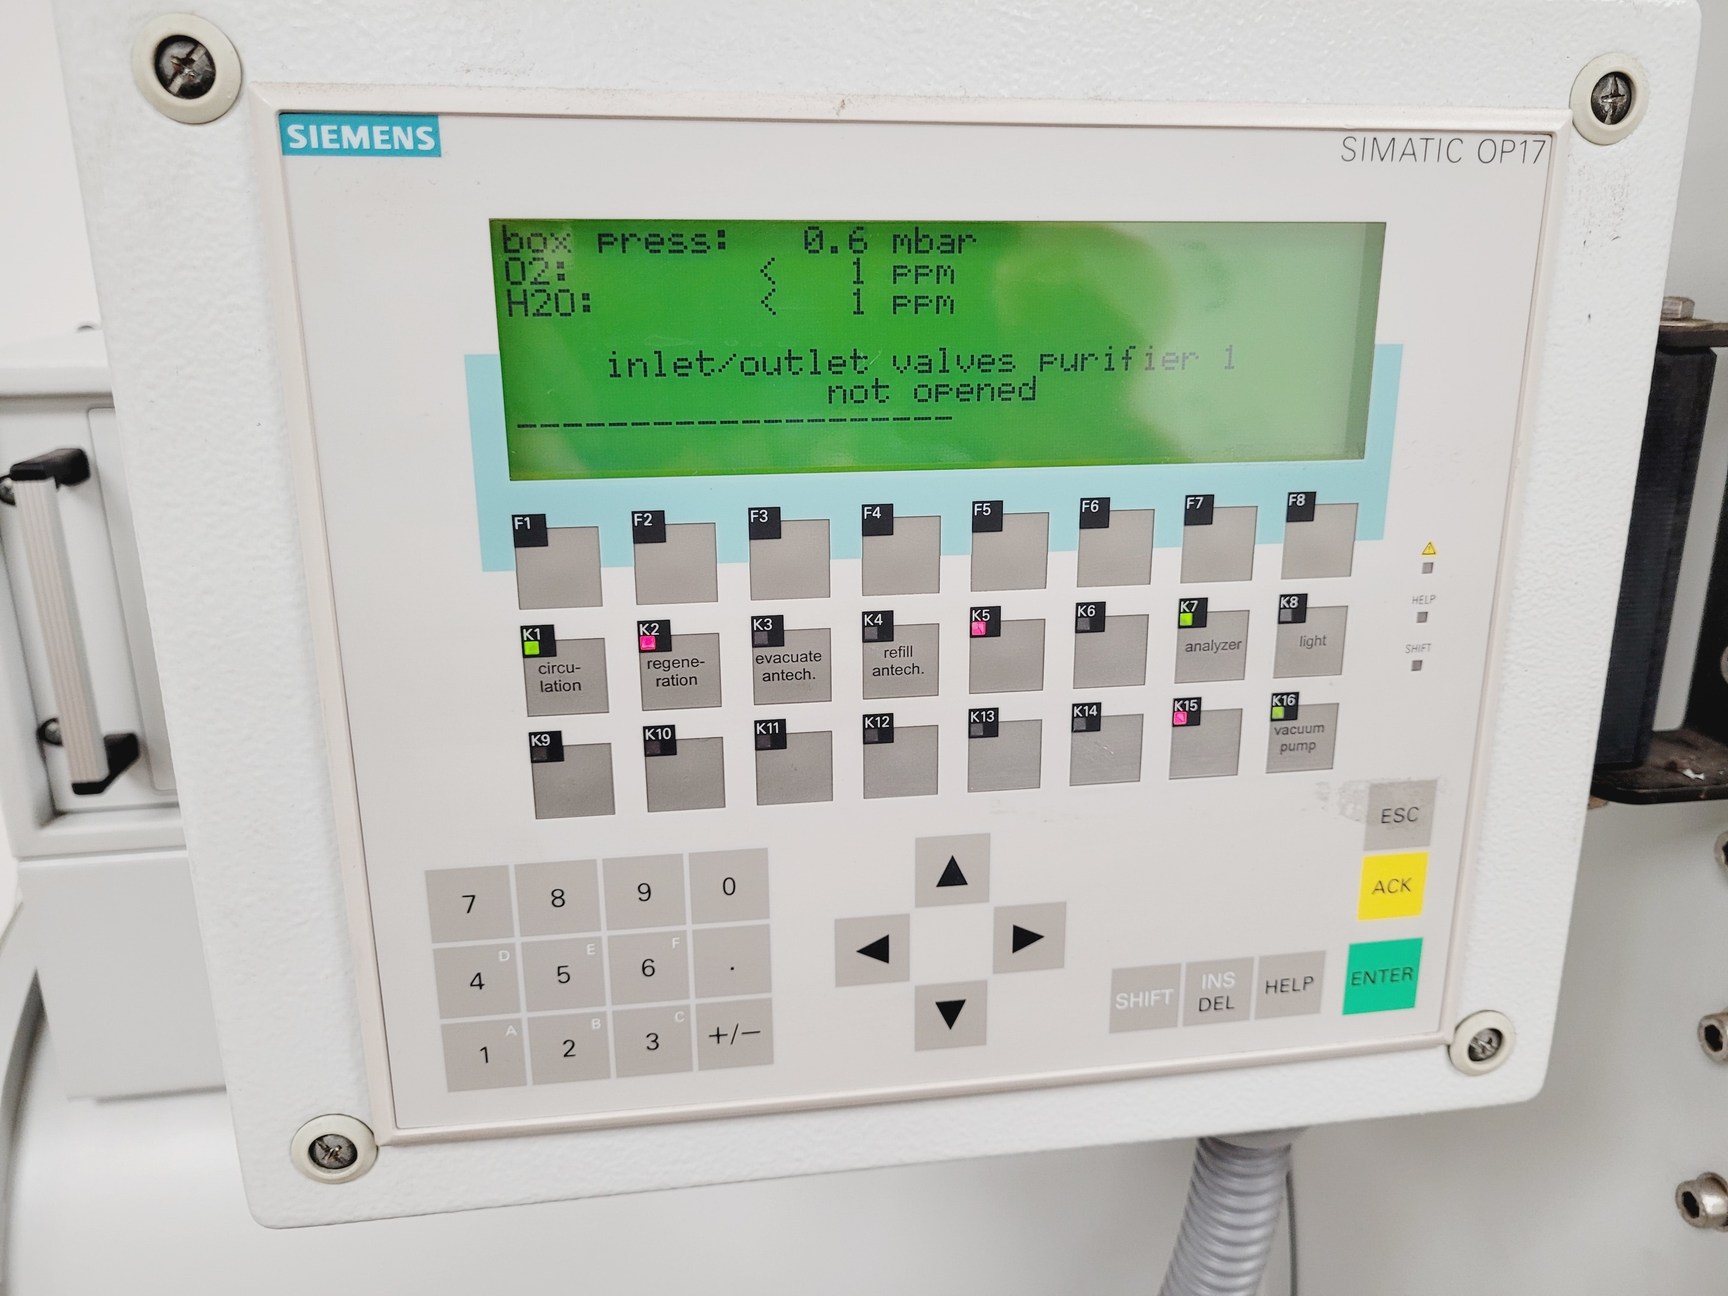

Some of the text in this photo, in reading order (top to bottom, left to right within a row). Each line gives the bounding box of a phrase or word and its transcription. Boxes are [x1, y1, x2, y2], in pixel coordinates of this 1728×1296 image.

[287, 124, 435, 150] SIEMENS
[1341, 136, 1546, 164] SIMATIC OP17
[503, 225, 977, 255] box press: 0.6 mbar
[852, 257, 865, 285] 1
[892, 264, 956, 286] ppm
[507, 289, 591, 317] H2O:
[852, 288, 865, 315] 1
[892, 295, 956, 316] ppm
[608, 345, 1236, 378] inlet/outlet valves purifier 1
[828, 375, 1038, 405] not opened
[1082, 500, 1099, 512] F6
[1187, 497, 1204, 509] F7
[1289, 494, 1306, 506] F8
[750, 510, 768, 522] F3
[864, 506, 881, 519] F4
[974, 503, 991, 516] F5
[514, 517, 531, 530] F1
[634, 513, 652, 526] F2
[1280, 596, 1298, 608] K8
[1412, 594, 1436, 604] HELP
[1078, 605, 1096, 617] K6
[1180, 601, 1198, 613] K7
[864, 614, 883, 626] K4
[972, 609, 990, 622] K5
[640, 624, 659, 636] K2
[753, 618, 772, 631] K3
[523, 628, 540, 640] K1
[1185, 639, 1242, 655] analyzer
[1300, 634, 1326, 650] light
[884, 645, 913, 658] refill
[1405, 644, 1432, 654] SHIFT
[756, 650, 822, 664] evacuate
[538, 662, 581, 675] circu-
[647, 656, 705, 672] regene-
[873, 663, 924, 677] antech.
[656, 675, 697, 687] ration
[762, 668, 816, 682] antech.
[540, 679, 581, 693] lation
[1174, 700, 1198, 712] K15
[1272, 694, 1295, 706] K16
[971, 711, 994, 723] K13
[1074, 705, 1097, 717] K14
[757, 722, 779, 735] K11
[865, 716, 890, 729] K12
[1274, 723, 1325, 735] vacuum
[531, 734, 550, 746] K9
[646, 728, 672, 740] K10
[1280, 741, 1316, 755] pump
[1380, 807, 1419, 824] ESC
[638, 883, 651, 902] 9
[723, 877, 736, 895] 0
[1371, 878, 1412, 895] ACK
[462, 894, 476, 914] 7
[551, 888, 565, 907] 8
[587, 944, 595, 955] E
[672, 937, 680, 949] F
[499, 951, 510, 961] D
[641, 958, 655, 977] 6
[469, 972, 485, 990] 4
[557, 965, 570, 984] 5
[1201, 971, 1236, 990] INS
[1351, 966, 1413, 986] ENTER
[1265, 976, 1314, 995] HELP
[1115, 989, 1174, 1009] SHIFT
[1198, 995, 1235, 1012] DEL
[592, 1019, 601, 1029] B
[674, 1012, 685, 1023] C
[505, 1025, 518, 1037] A
[563, 1039, 576, 1057] 2
[646, 1033, 659, 1050] 3
[479, 1047, 488, 1064] 1
